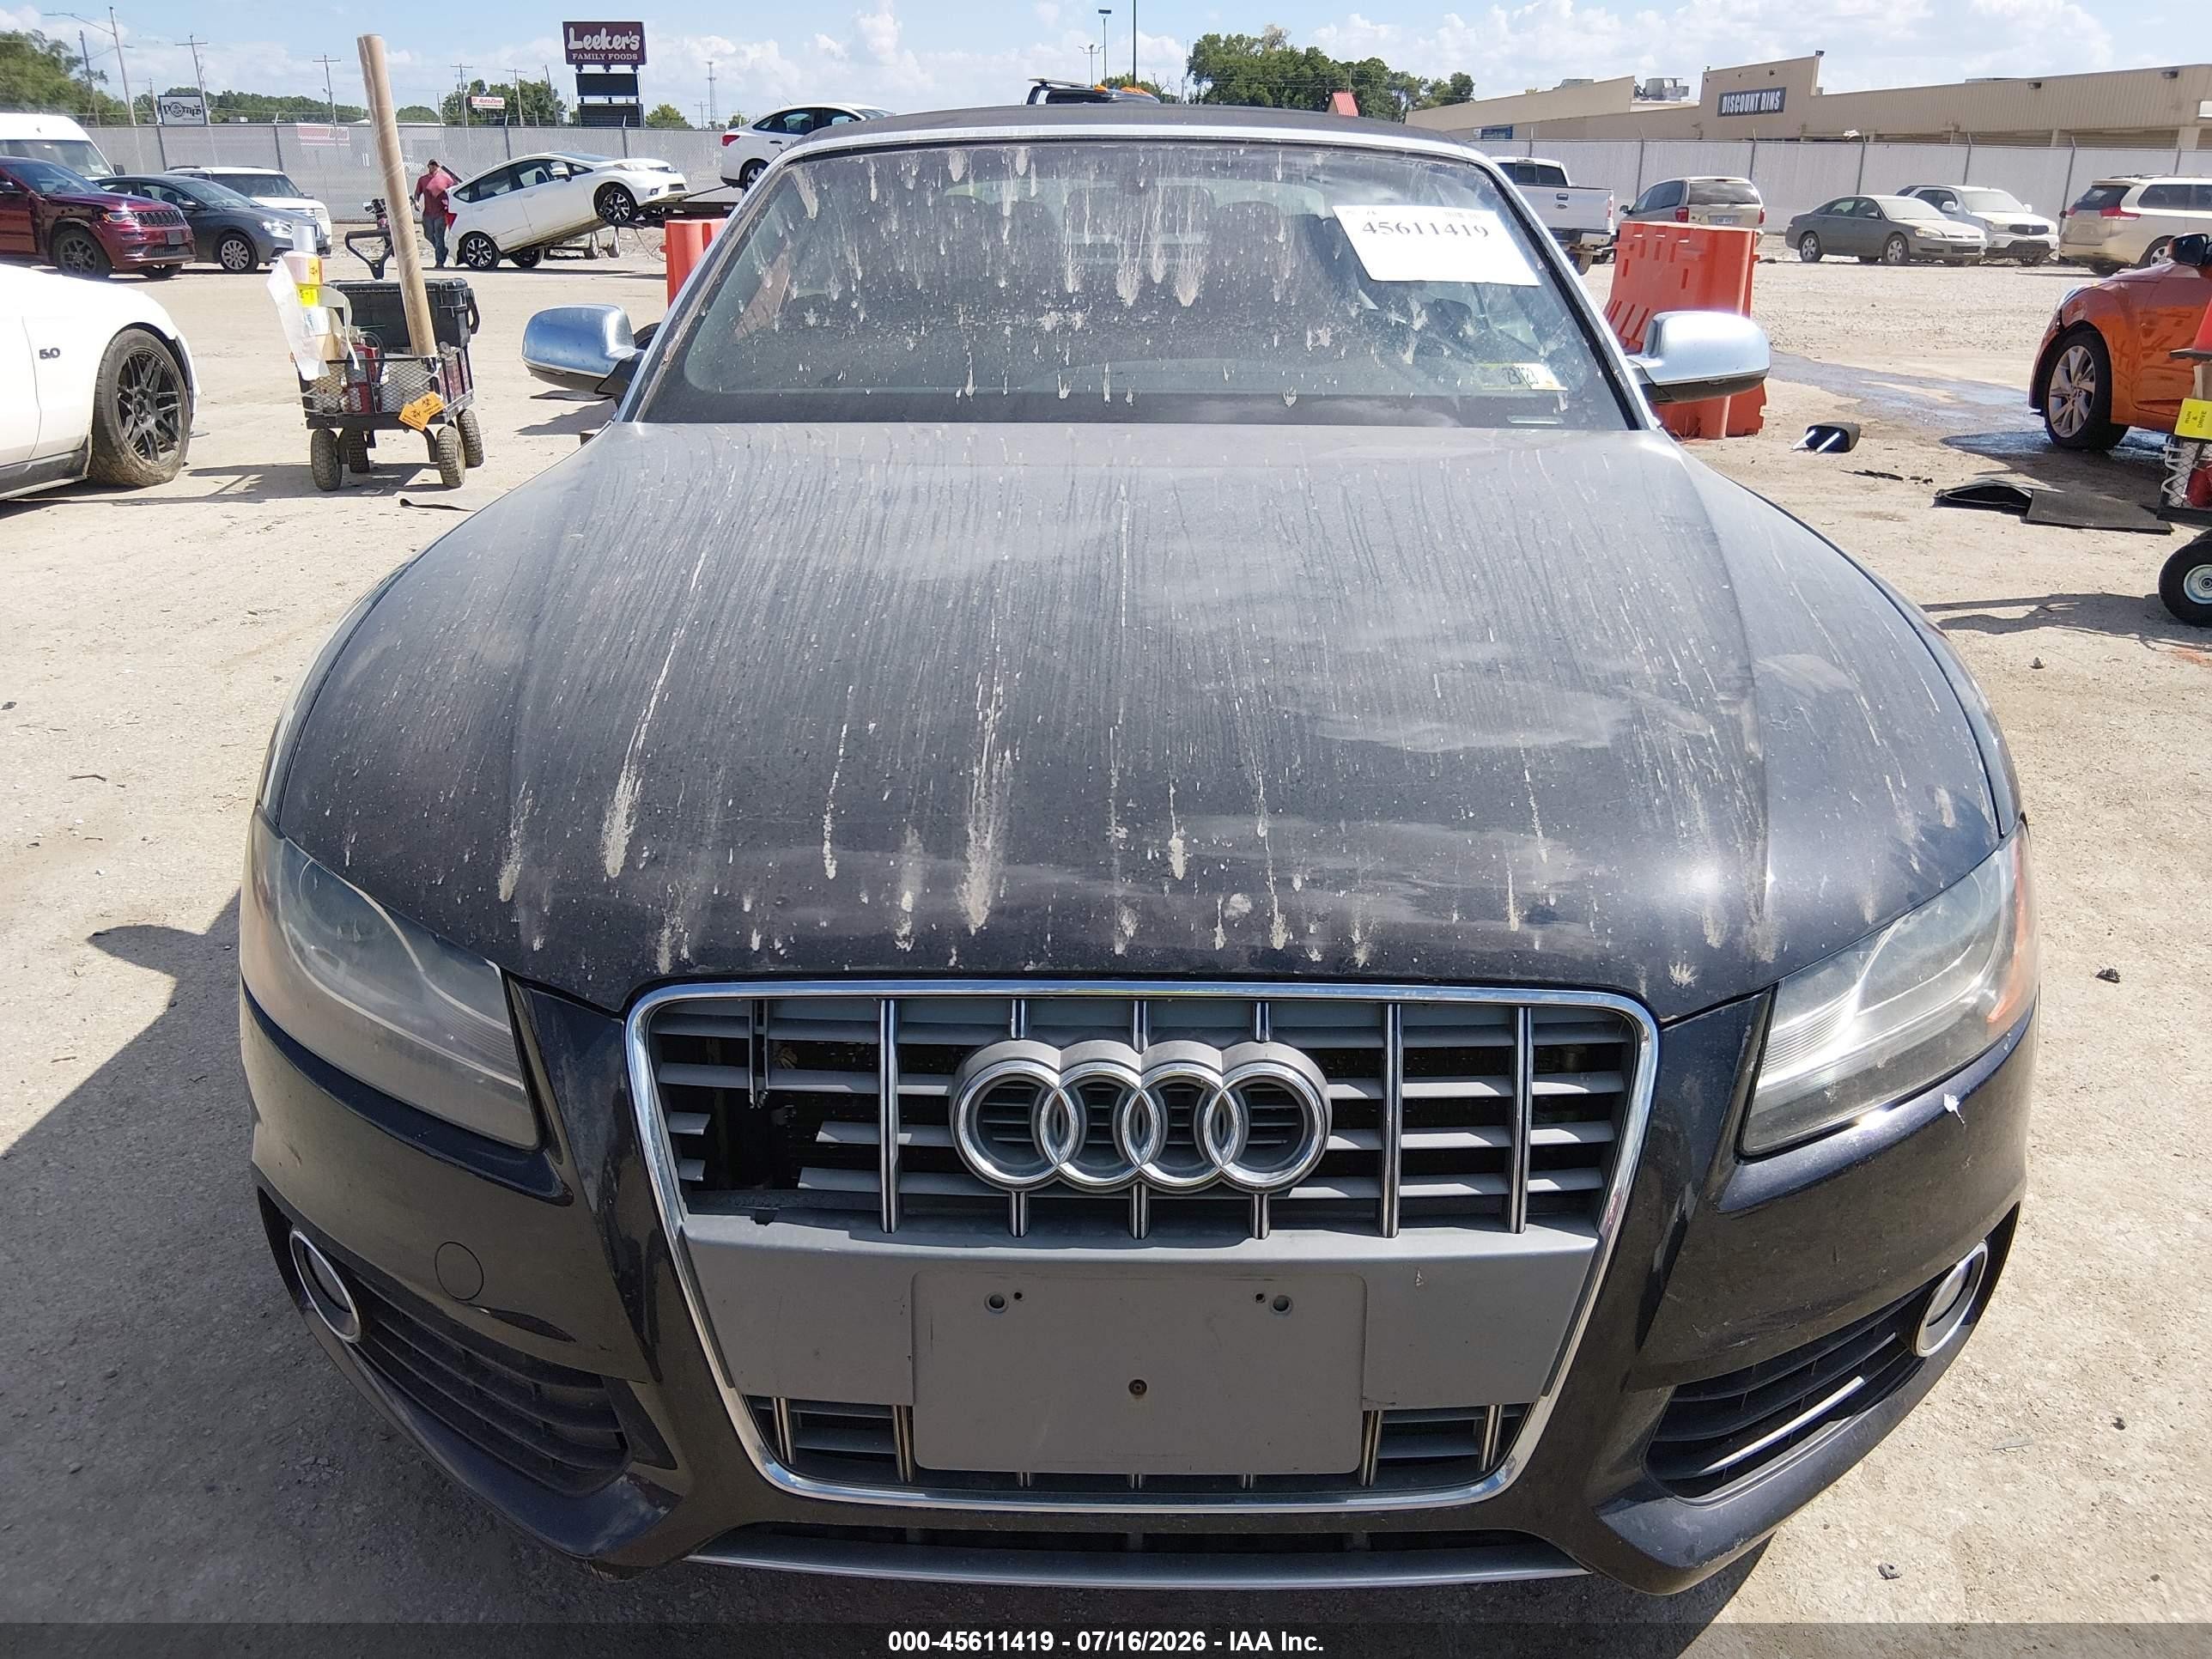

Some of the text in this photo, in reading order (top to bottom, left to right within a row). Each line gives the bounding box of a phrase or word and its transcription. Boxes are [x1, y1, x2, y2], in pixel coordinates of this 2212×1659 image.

[568, 27, 641, 51] Leeker's
[1721, 90, 1781, 114] DISCOUNT BINS
[1361, 221, 1490, 238] 45611419
